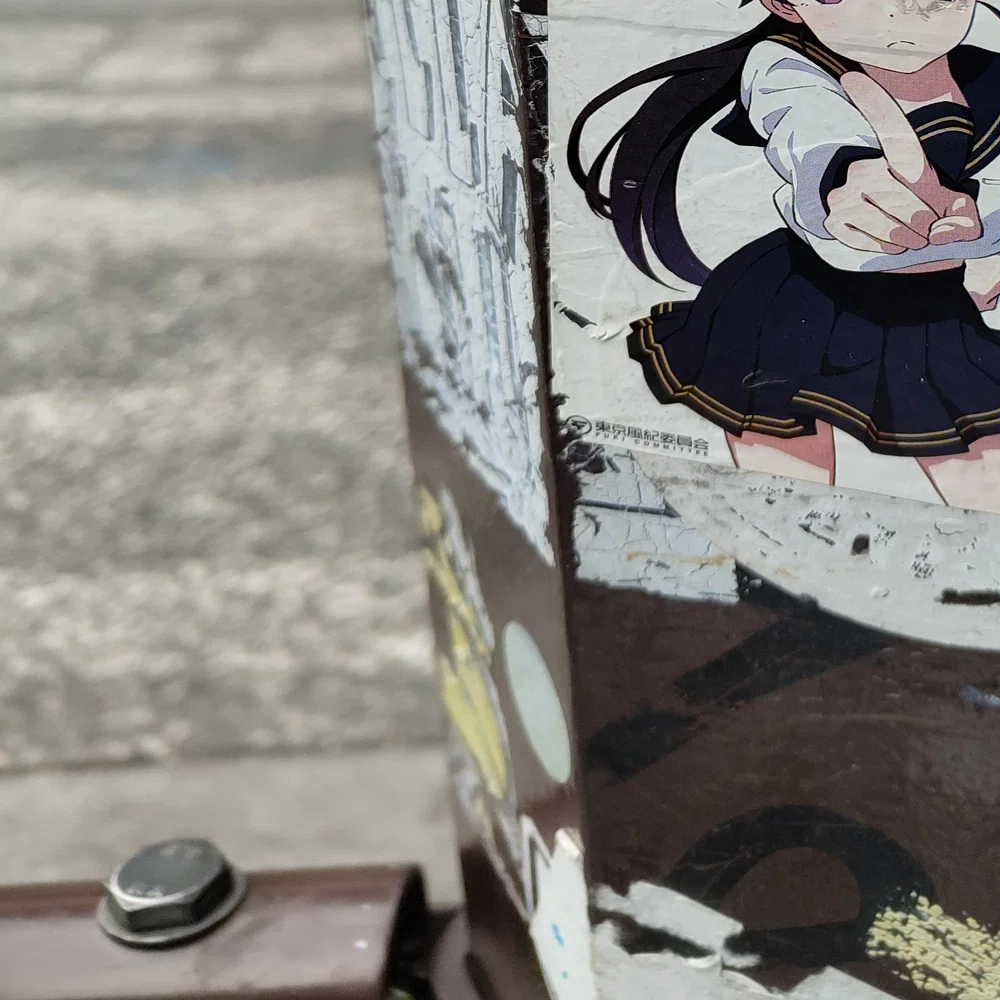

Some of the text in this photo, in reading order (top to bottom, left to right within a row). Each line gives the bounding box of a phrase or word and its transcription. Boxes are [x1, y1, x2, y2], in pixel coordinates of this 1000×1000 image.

[595, 420, 710, 451] 東京風紀委員会
[595, 431, 709, 457] FUKI COMMITTEE
